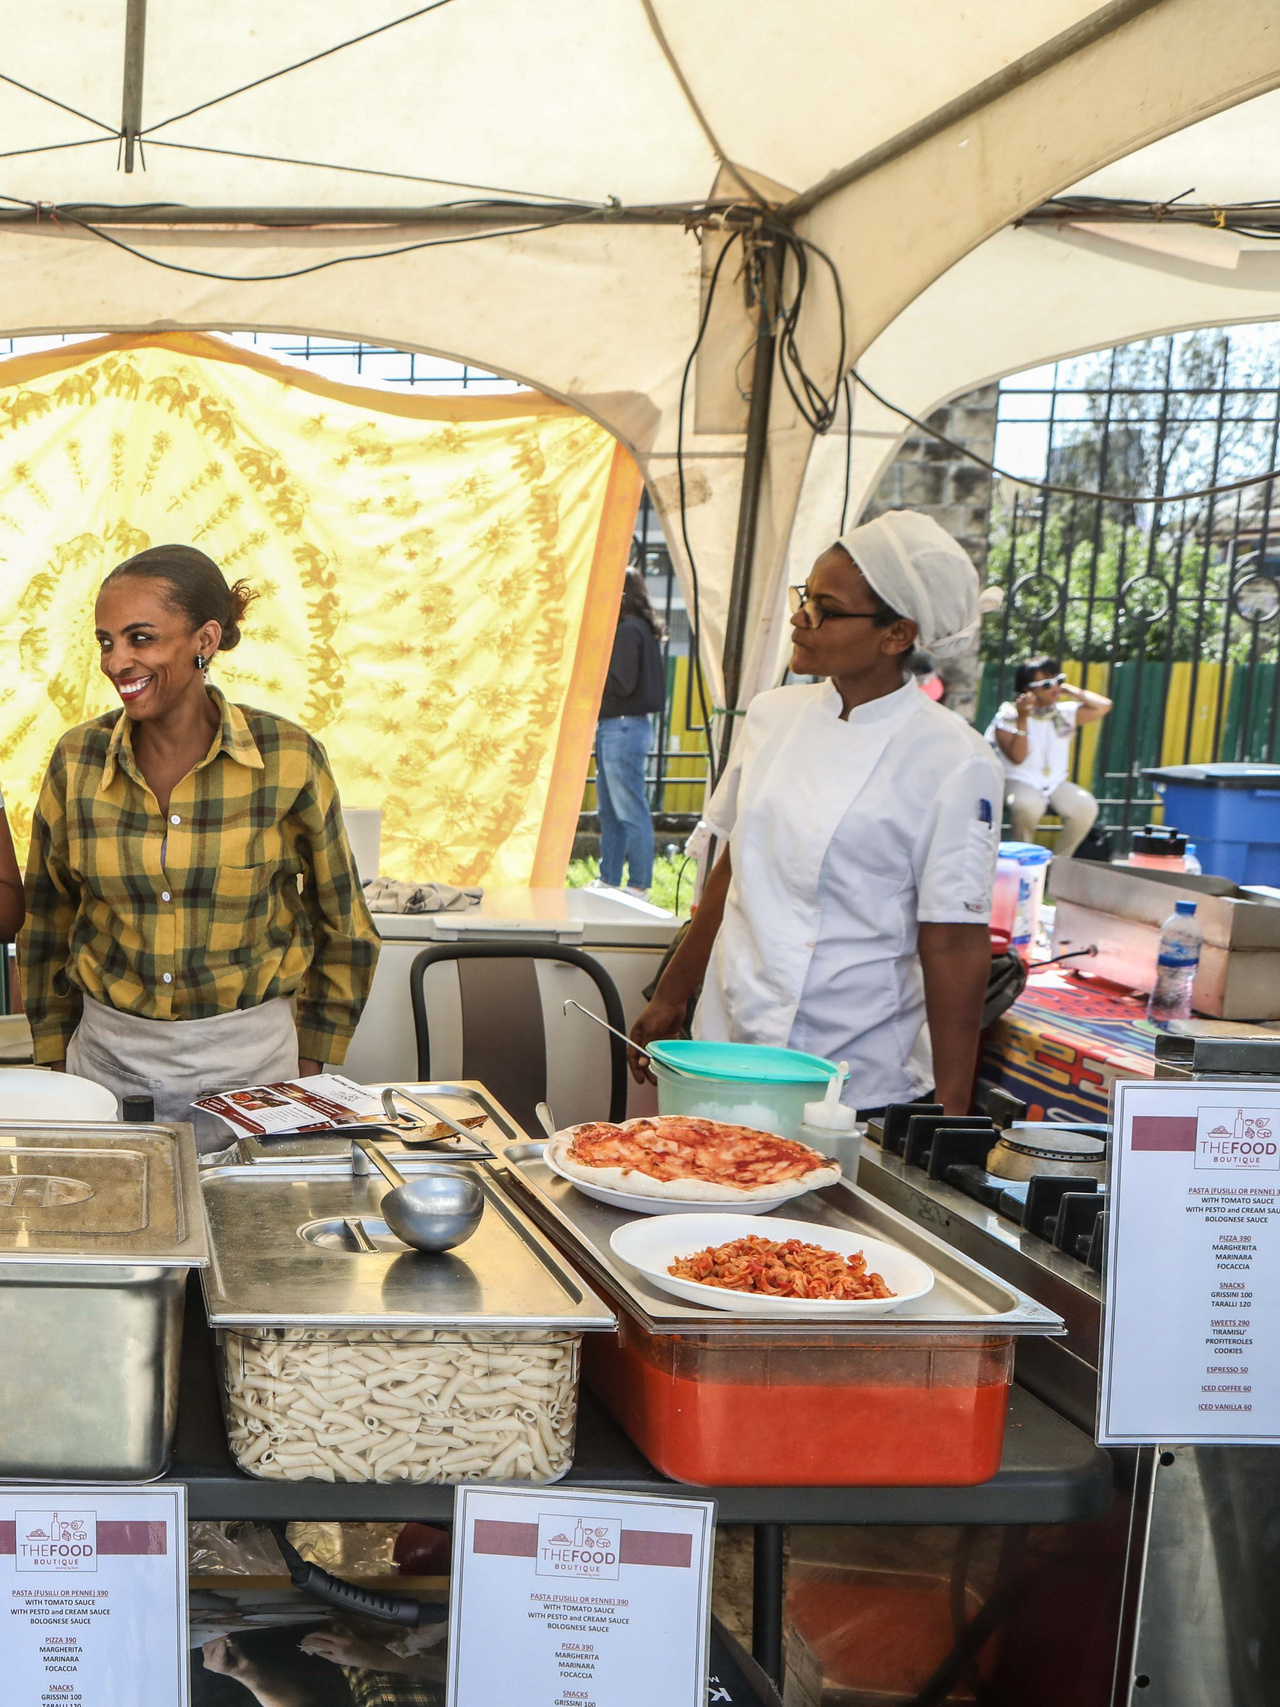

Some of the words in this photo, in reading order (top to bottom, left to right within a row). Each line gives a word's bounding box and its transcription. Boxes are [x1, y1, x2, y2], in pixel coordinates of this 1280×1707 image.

[554, 1564, 601, 1572] BOUTIQUE
[591, 1597, 616, 1605] PENNE)
[547, 1623, 587, 1631] BOLOGNESE
[554, 1652, 600, 1661] MARGHERITA
[558, 1661, 595, 1670] MARINARA
[560, 1671, 593, 1679] FOCACCIA
[563, 1690, 589, 1698] SNACKS
